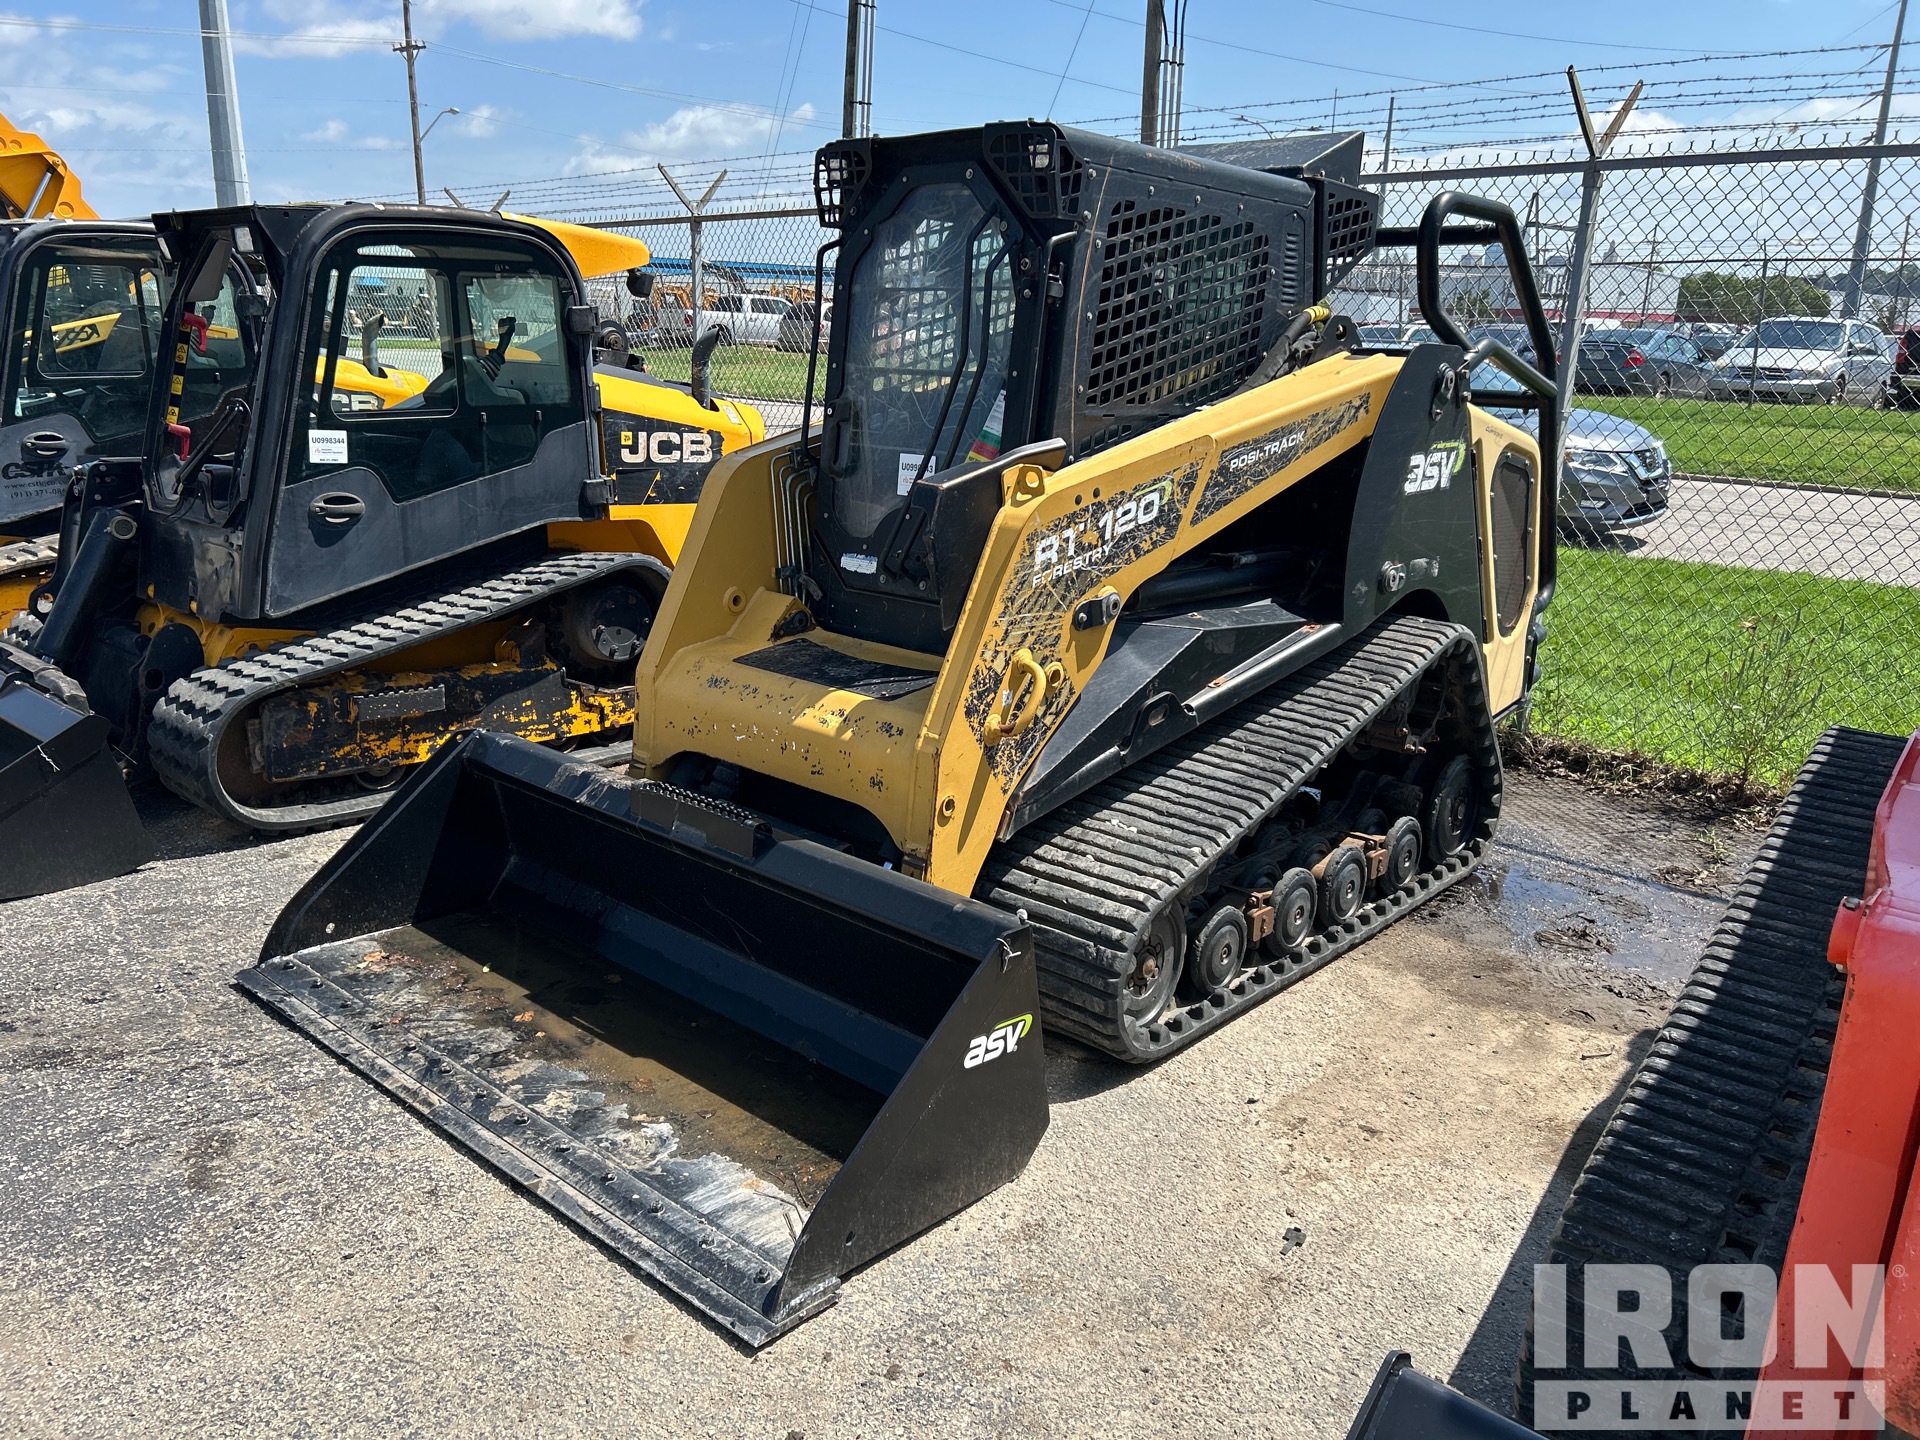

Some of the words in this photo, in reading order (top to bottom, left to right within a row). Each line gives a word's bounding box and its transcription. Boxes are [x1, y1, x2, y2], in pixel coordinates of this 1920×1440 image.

[621, 431, 713, 463] JCB
[1229, 430, 1306, 471] POSI-TRACK
[1032, 541, 1114, 588] FORESTRY
